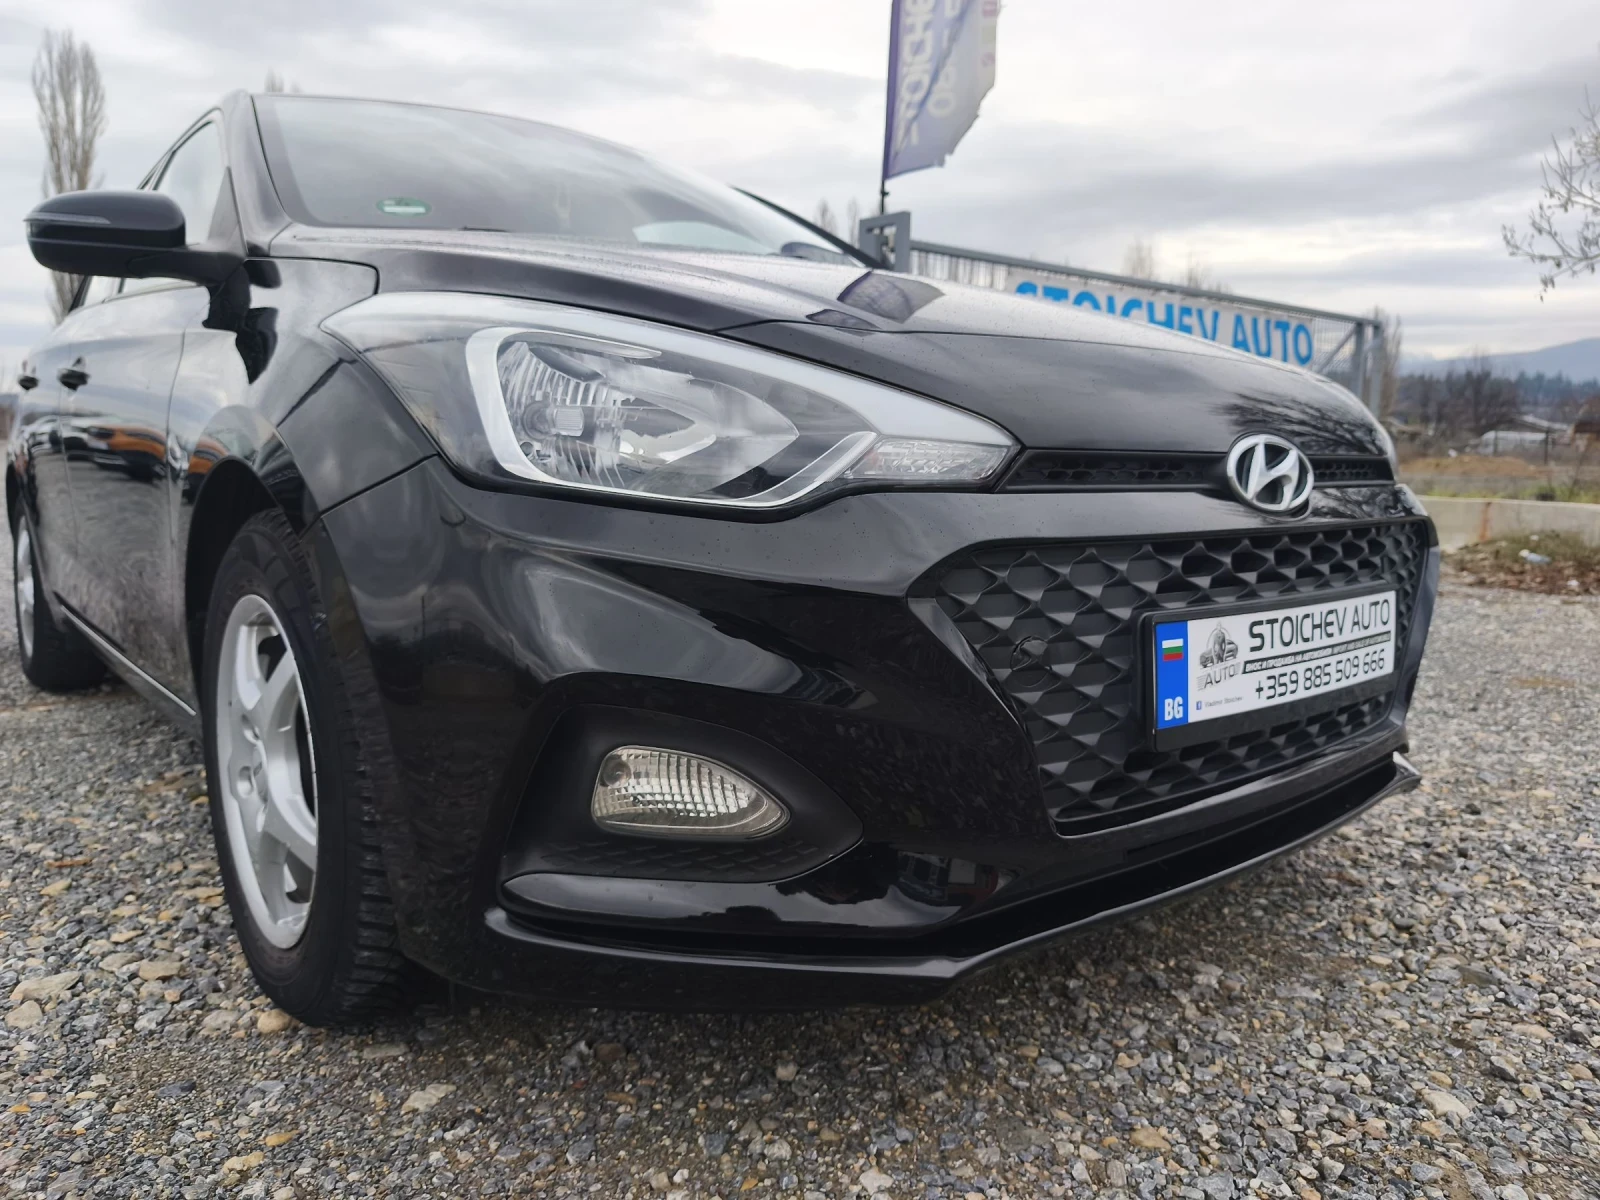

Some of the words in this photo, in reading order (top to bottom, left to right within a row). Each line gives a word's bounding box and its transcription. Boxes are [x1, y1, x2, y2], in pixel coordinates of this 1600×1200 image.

[1232, 314, 1313, 366] AUTO
[1248, 608, 1347, 652] STOICHEV
[1351, 599, 1390, 633] AUTO
[1204, 664, 1235, 689] AUTO
[1255, 667, 1298, 700] +359
[1304, 663, 1332, 690] 885
[1335, 655, 1360, 682] 509
[1363, 648, 1385, 674] 666
[1164, 696, 1183, 721] BG
